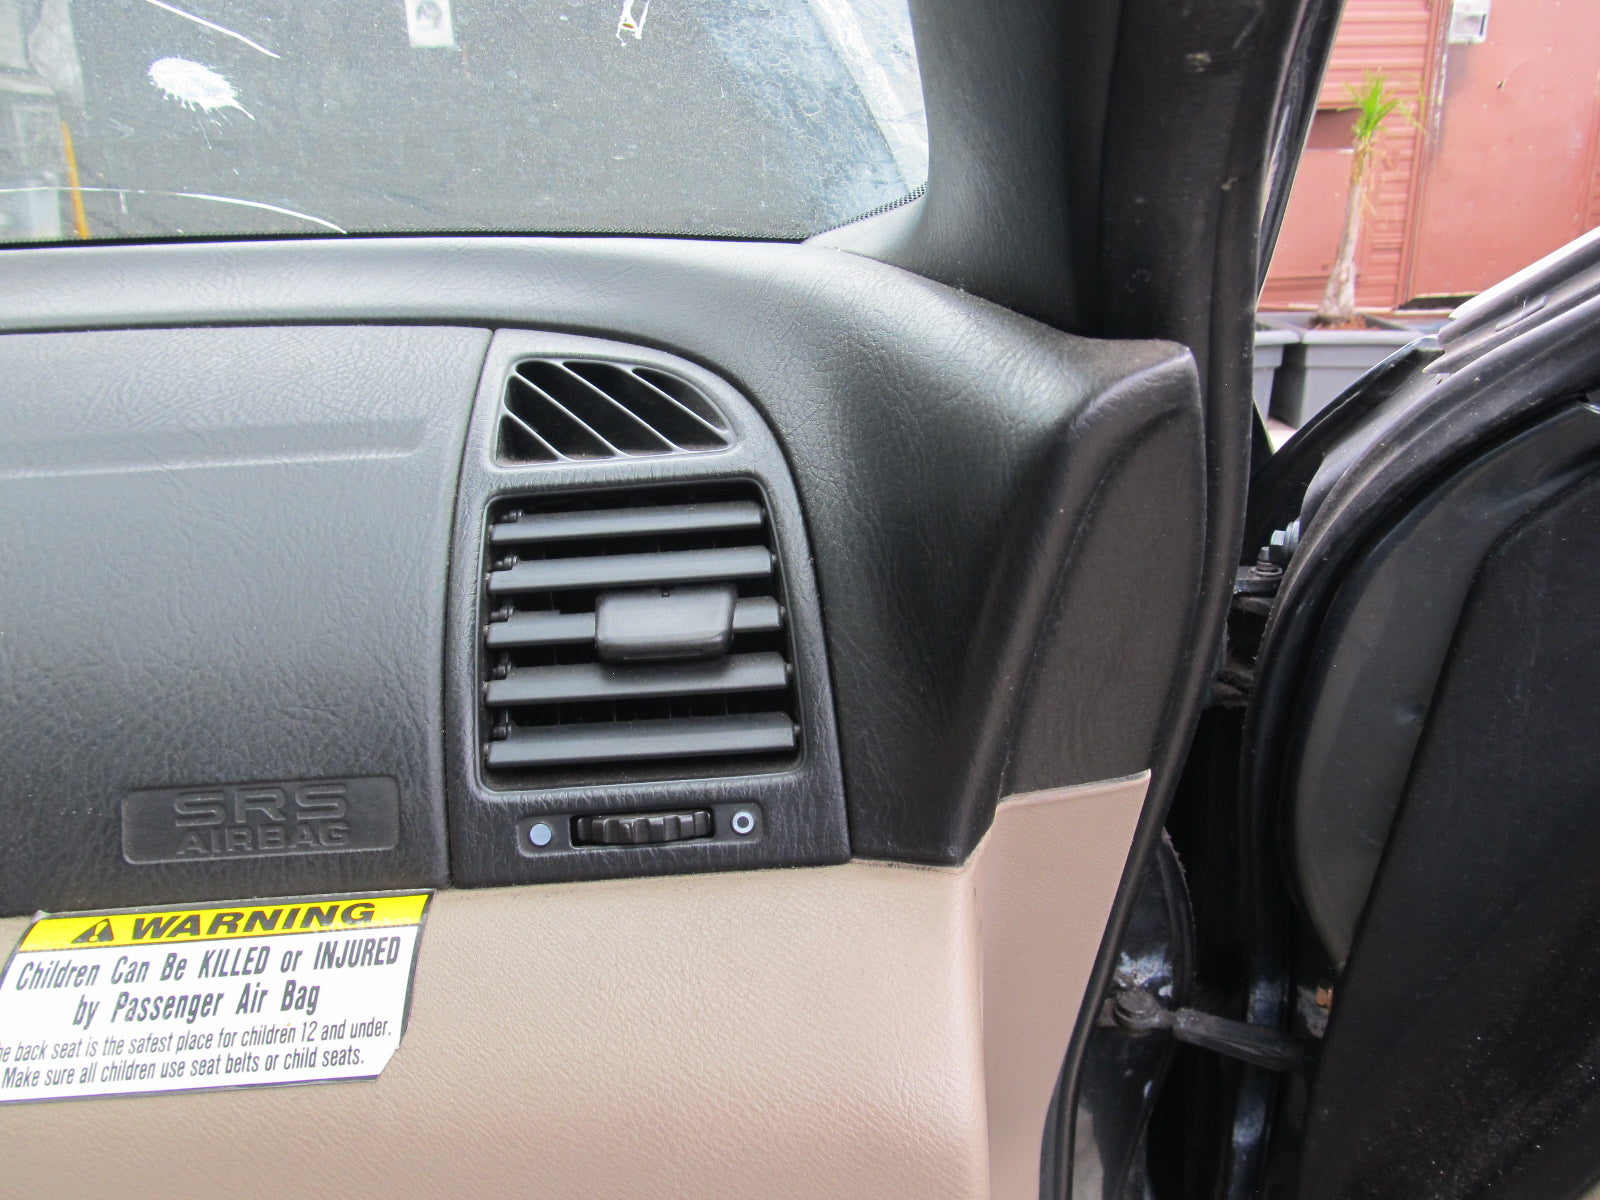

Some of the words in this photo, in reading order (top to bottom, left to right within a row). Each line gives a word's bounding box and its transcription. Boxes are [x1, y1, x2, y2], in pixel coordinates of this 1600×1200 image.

[173, 784, 348, 828] SRS
[176, 822, 350, 855] AIRBAG
[132, 902, 376, 940] WARNING
[16, 959, 101, 991] Children
[110, 956, 151, 985] Can
[159, 952, 188, 981] Be
[197, 945, 271, 979] KILLED
[280, 950, 303, 973] or
[313, 936, 401, 970] INJURED
[72, 994, 101, 1030] by
[110, 991, 224, 1024] Passenger
[235, 981, 269, 1015] Air
[280, 979, 321, 1016] Bag
[14, 1040, 48, 1062] back
[51, 1038, 83, 1060] seat
[85, 1036, 98, 1057] is
[102, 1035, 125, 1056] the
[128, 1032, 174, 1055] safest
[175, 1030, 214, 1055] place
[217, 1027, 238, 1048] for
[240, 1023, 296, 1047] children
[301, 1020, 319, 1042] 12
[320, 1018, 347, 1040] and
[349, 1016, 392, 1039] under.
[1, 1066, 40, 1089] Make
[44, 1067, 75, 1086] sure
[79, 1061, 98, 1084] all
[100, 1058, 157, 1082] children
[160, 1060, 185, 1079] use
[190, 1054, 222, 1077] seat
[224, 1051, 260, 1075] belts
[264, 1054, 280, 1071] or
[283, 1046, 318, 1071] child
[321, 1044, 365, 1068] seats.
